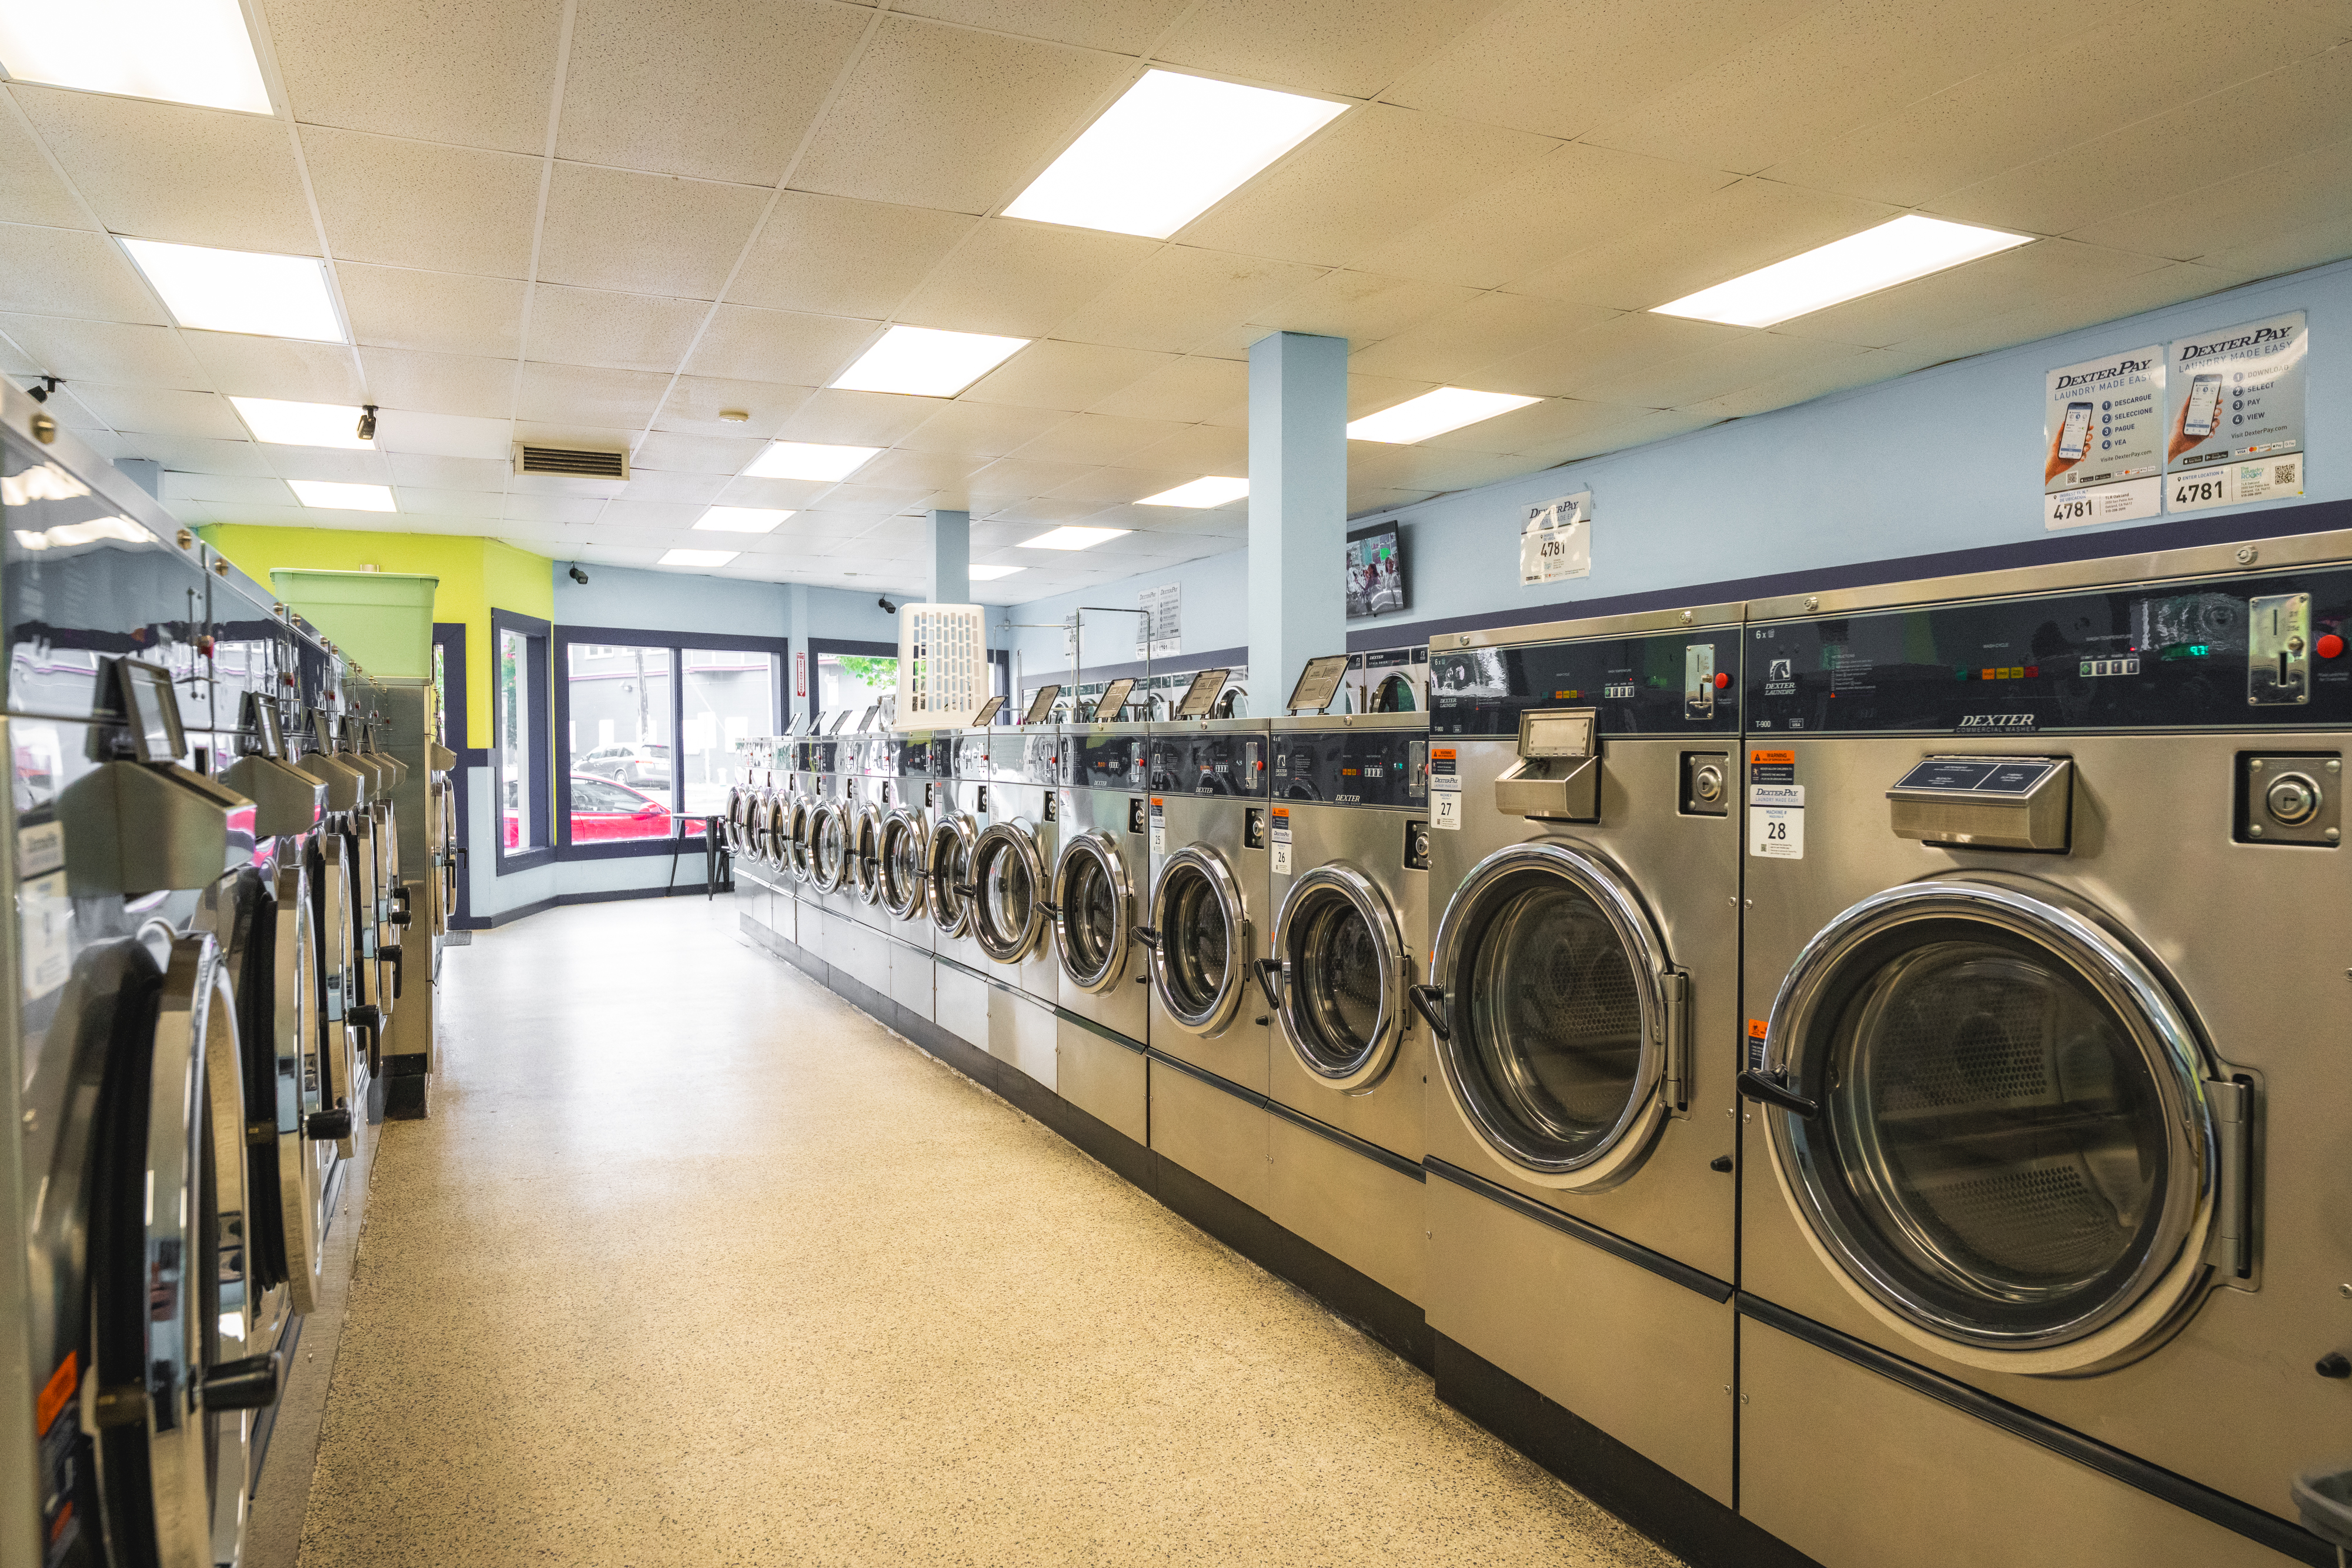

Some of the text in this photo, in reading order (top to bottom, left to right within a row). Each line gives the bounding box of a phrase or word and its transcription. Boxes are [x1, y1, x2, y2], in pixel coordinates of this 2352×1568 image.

[2179, 340, 2292, 373] LAUNDRY MADE EASY
[2248, 365, 2289, 377] DOWNLOAD
[2054, 372, 2152, 401] LAUNDRY MADE EASY
[2247, 382, 2274, 393] SELECT
[2115, 394, 2151, 407] DESCARGUE
[2114, 407, 2153, 420] SELECCIONE
[2115, 423, 2135, 433] PAGUE
[2244, 425, 2287, 436] DexterPay.com
[2115, 450, 2151, 460] DexterPay.com
[2176, 480, 2222, 503] 4781
[2054, 500, 2092, 520] 4781
[1541, 541, 1565, 557] 4781
[1756, 630, 1761, 638] 6
[1959, 714, 2034, 727] DEXTER
[1441, 803, 1451, 815] 27
[1768, 823, 1786, 840] 28
[1155, 835, 1161, 844] 25
[1278, 852, 1285, 862] 26
